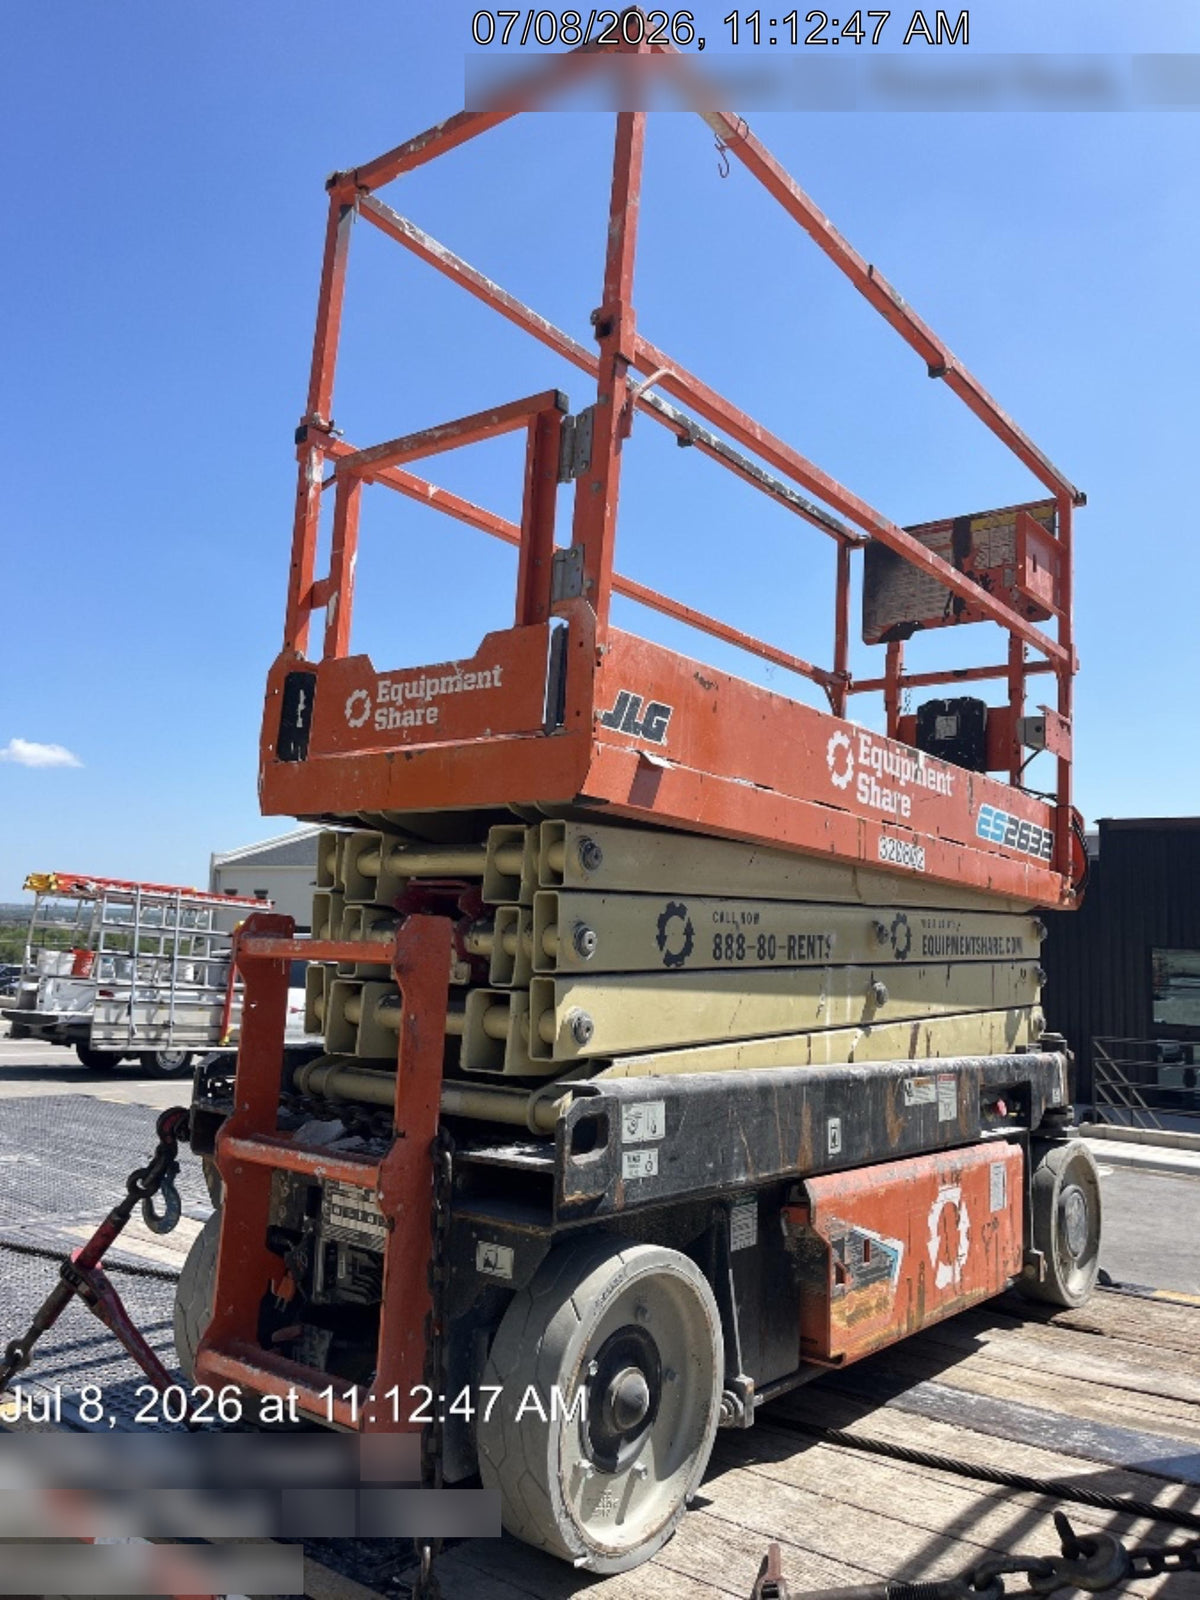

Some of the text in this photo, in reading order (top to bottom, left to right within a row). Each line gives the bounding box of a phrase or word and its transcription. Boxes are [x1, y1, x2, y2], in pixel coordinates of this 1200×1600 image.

[376, 664, 504, 706] Equipment
[374, 706, 439, 732] Share
[601, 690, 673, 744] JLG
[858, 732, 956, 797] Equipment
[856, 772, 912, 818] Share
[977, 804, 1055, 861] ES2632
[712, 911, 760, 925] CALL NOW
[712, 933, 831, 961] 888-80-RENTS
